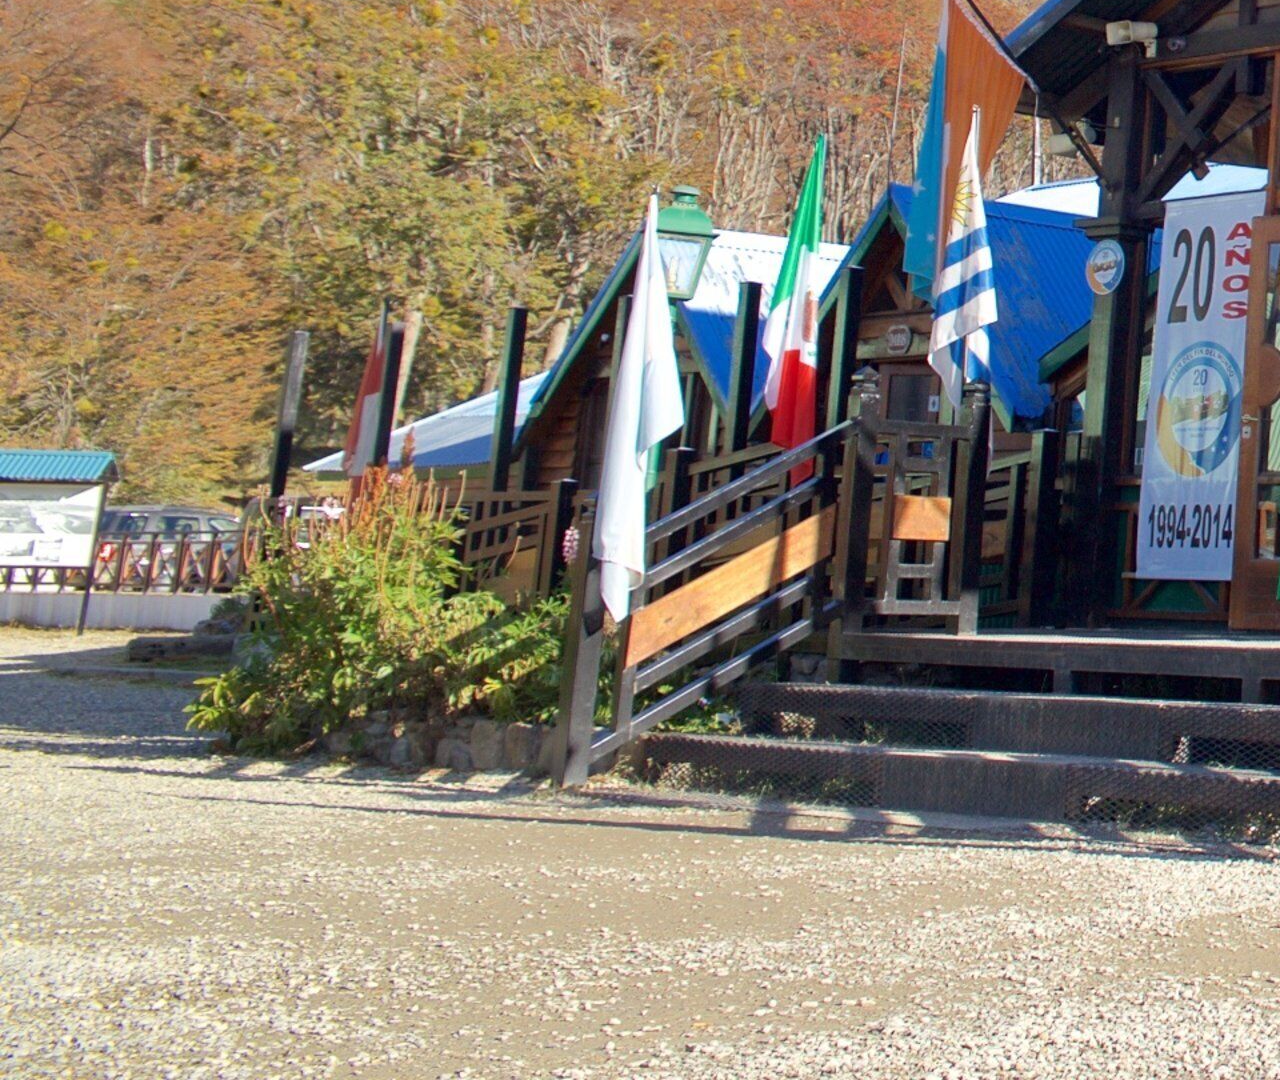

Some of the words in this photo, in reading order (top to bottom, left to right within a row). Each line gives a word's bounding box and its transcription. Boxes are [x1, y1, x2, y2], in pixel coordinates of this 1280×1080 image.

[1167, 226, 1216, 325] 20
[1222, 222, 1252, 320] AÑOS
[1204, 348, 1217, 357] DEL
[1193, 368, 1208, 387] 20
[1148, 503, 1233, 549] 1994-2014
